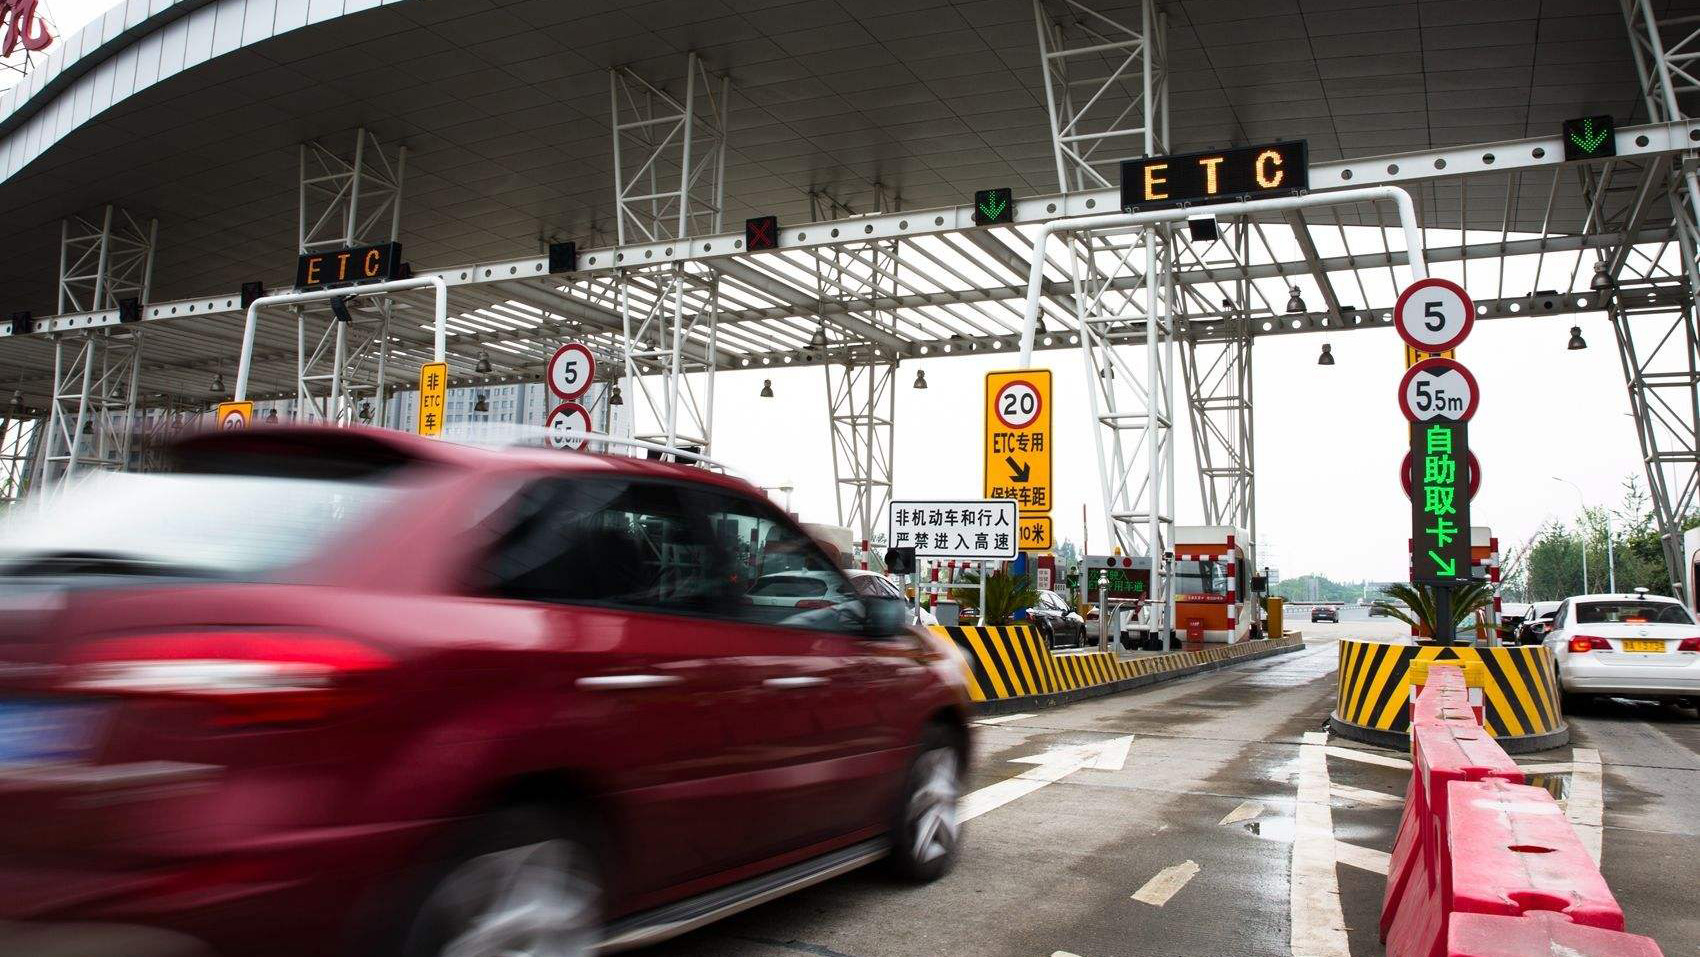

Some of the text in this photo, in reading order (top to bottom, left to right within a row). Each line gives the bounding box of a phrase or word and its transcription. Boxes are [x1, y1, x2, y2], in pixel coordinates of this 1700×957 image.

[1144, 149, 1284, 201] ETC
[307, 249, 380, 285] ETC
[1424, 300, 1446, 332] 5
[564, 361, 578, 385] 5
[1003, 392, 1035, 416] 20
[1416, 380, 1463, 412] 5.5m
[993, 432, 1044, 454] ETC专用
[1423, 424, 1458, 548] 自助取卡
[895, 508, 1010, 527] 非机动车和行人
[895, 532, 1010, 550] 严禁进入高速
